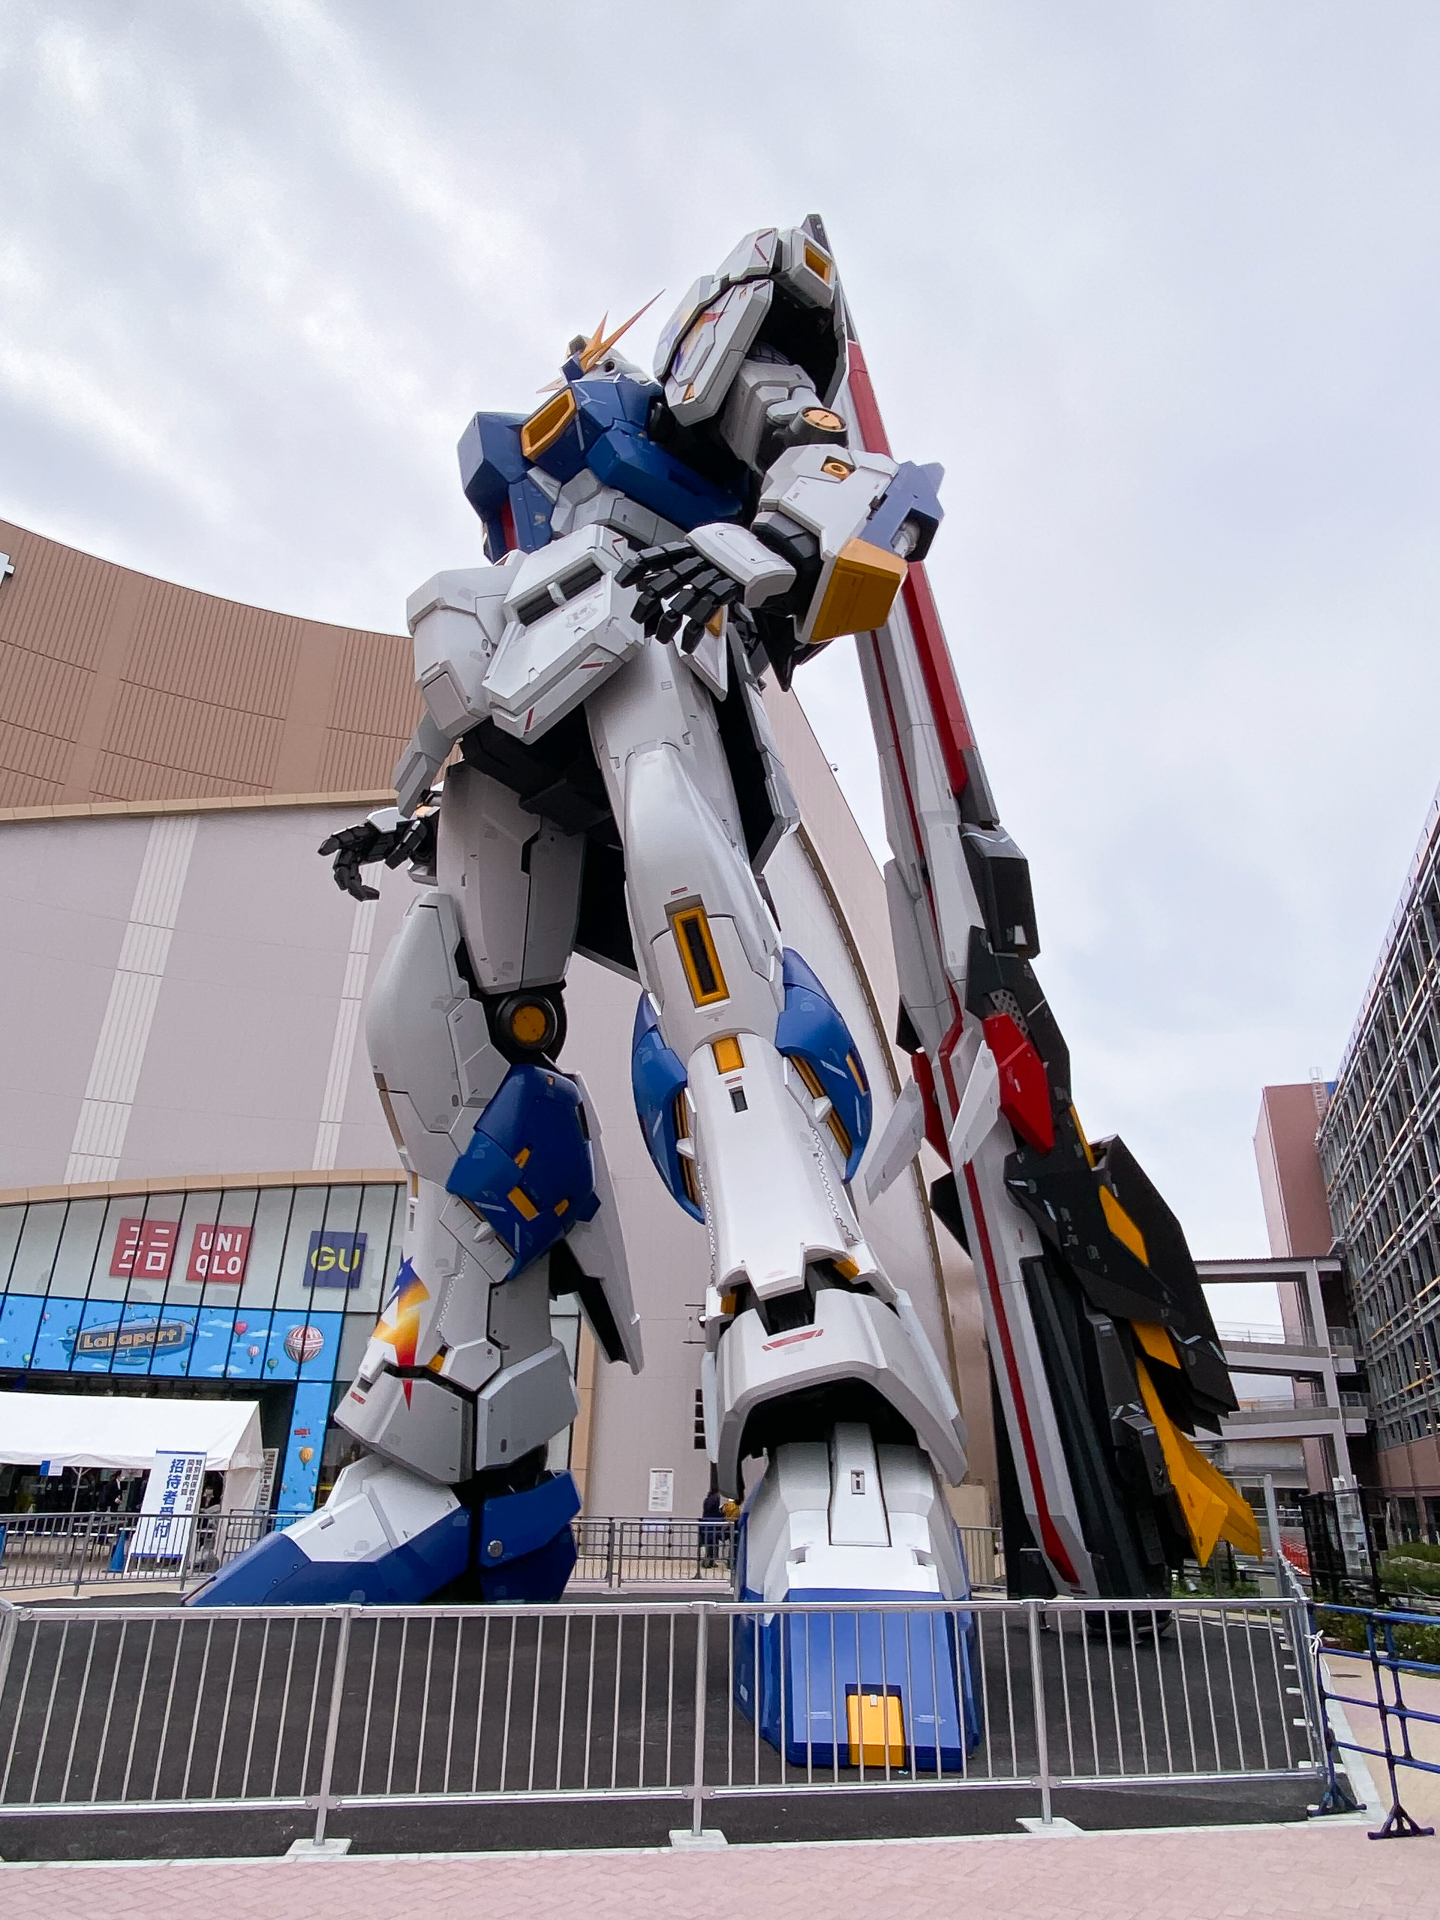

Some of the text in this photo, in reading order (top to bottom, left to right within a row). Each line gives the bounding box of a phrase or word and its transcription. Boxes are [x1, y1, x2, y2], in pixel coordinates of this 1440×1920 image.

[125, 1226, 170, 1248] ユニ
[200, 1231, 242, 1253] UNI
[118, 1249, 167, 1272] クロ
[195, 1254, 242, 1277] QLO
[310, 1245, 360, 1272] GU
[83, 1329, 177, 1349] LaLaport
[154, 1458, 186, 1538] 招待者受付
